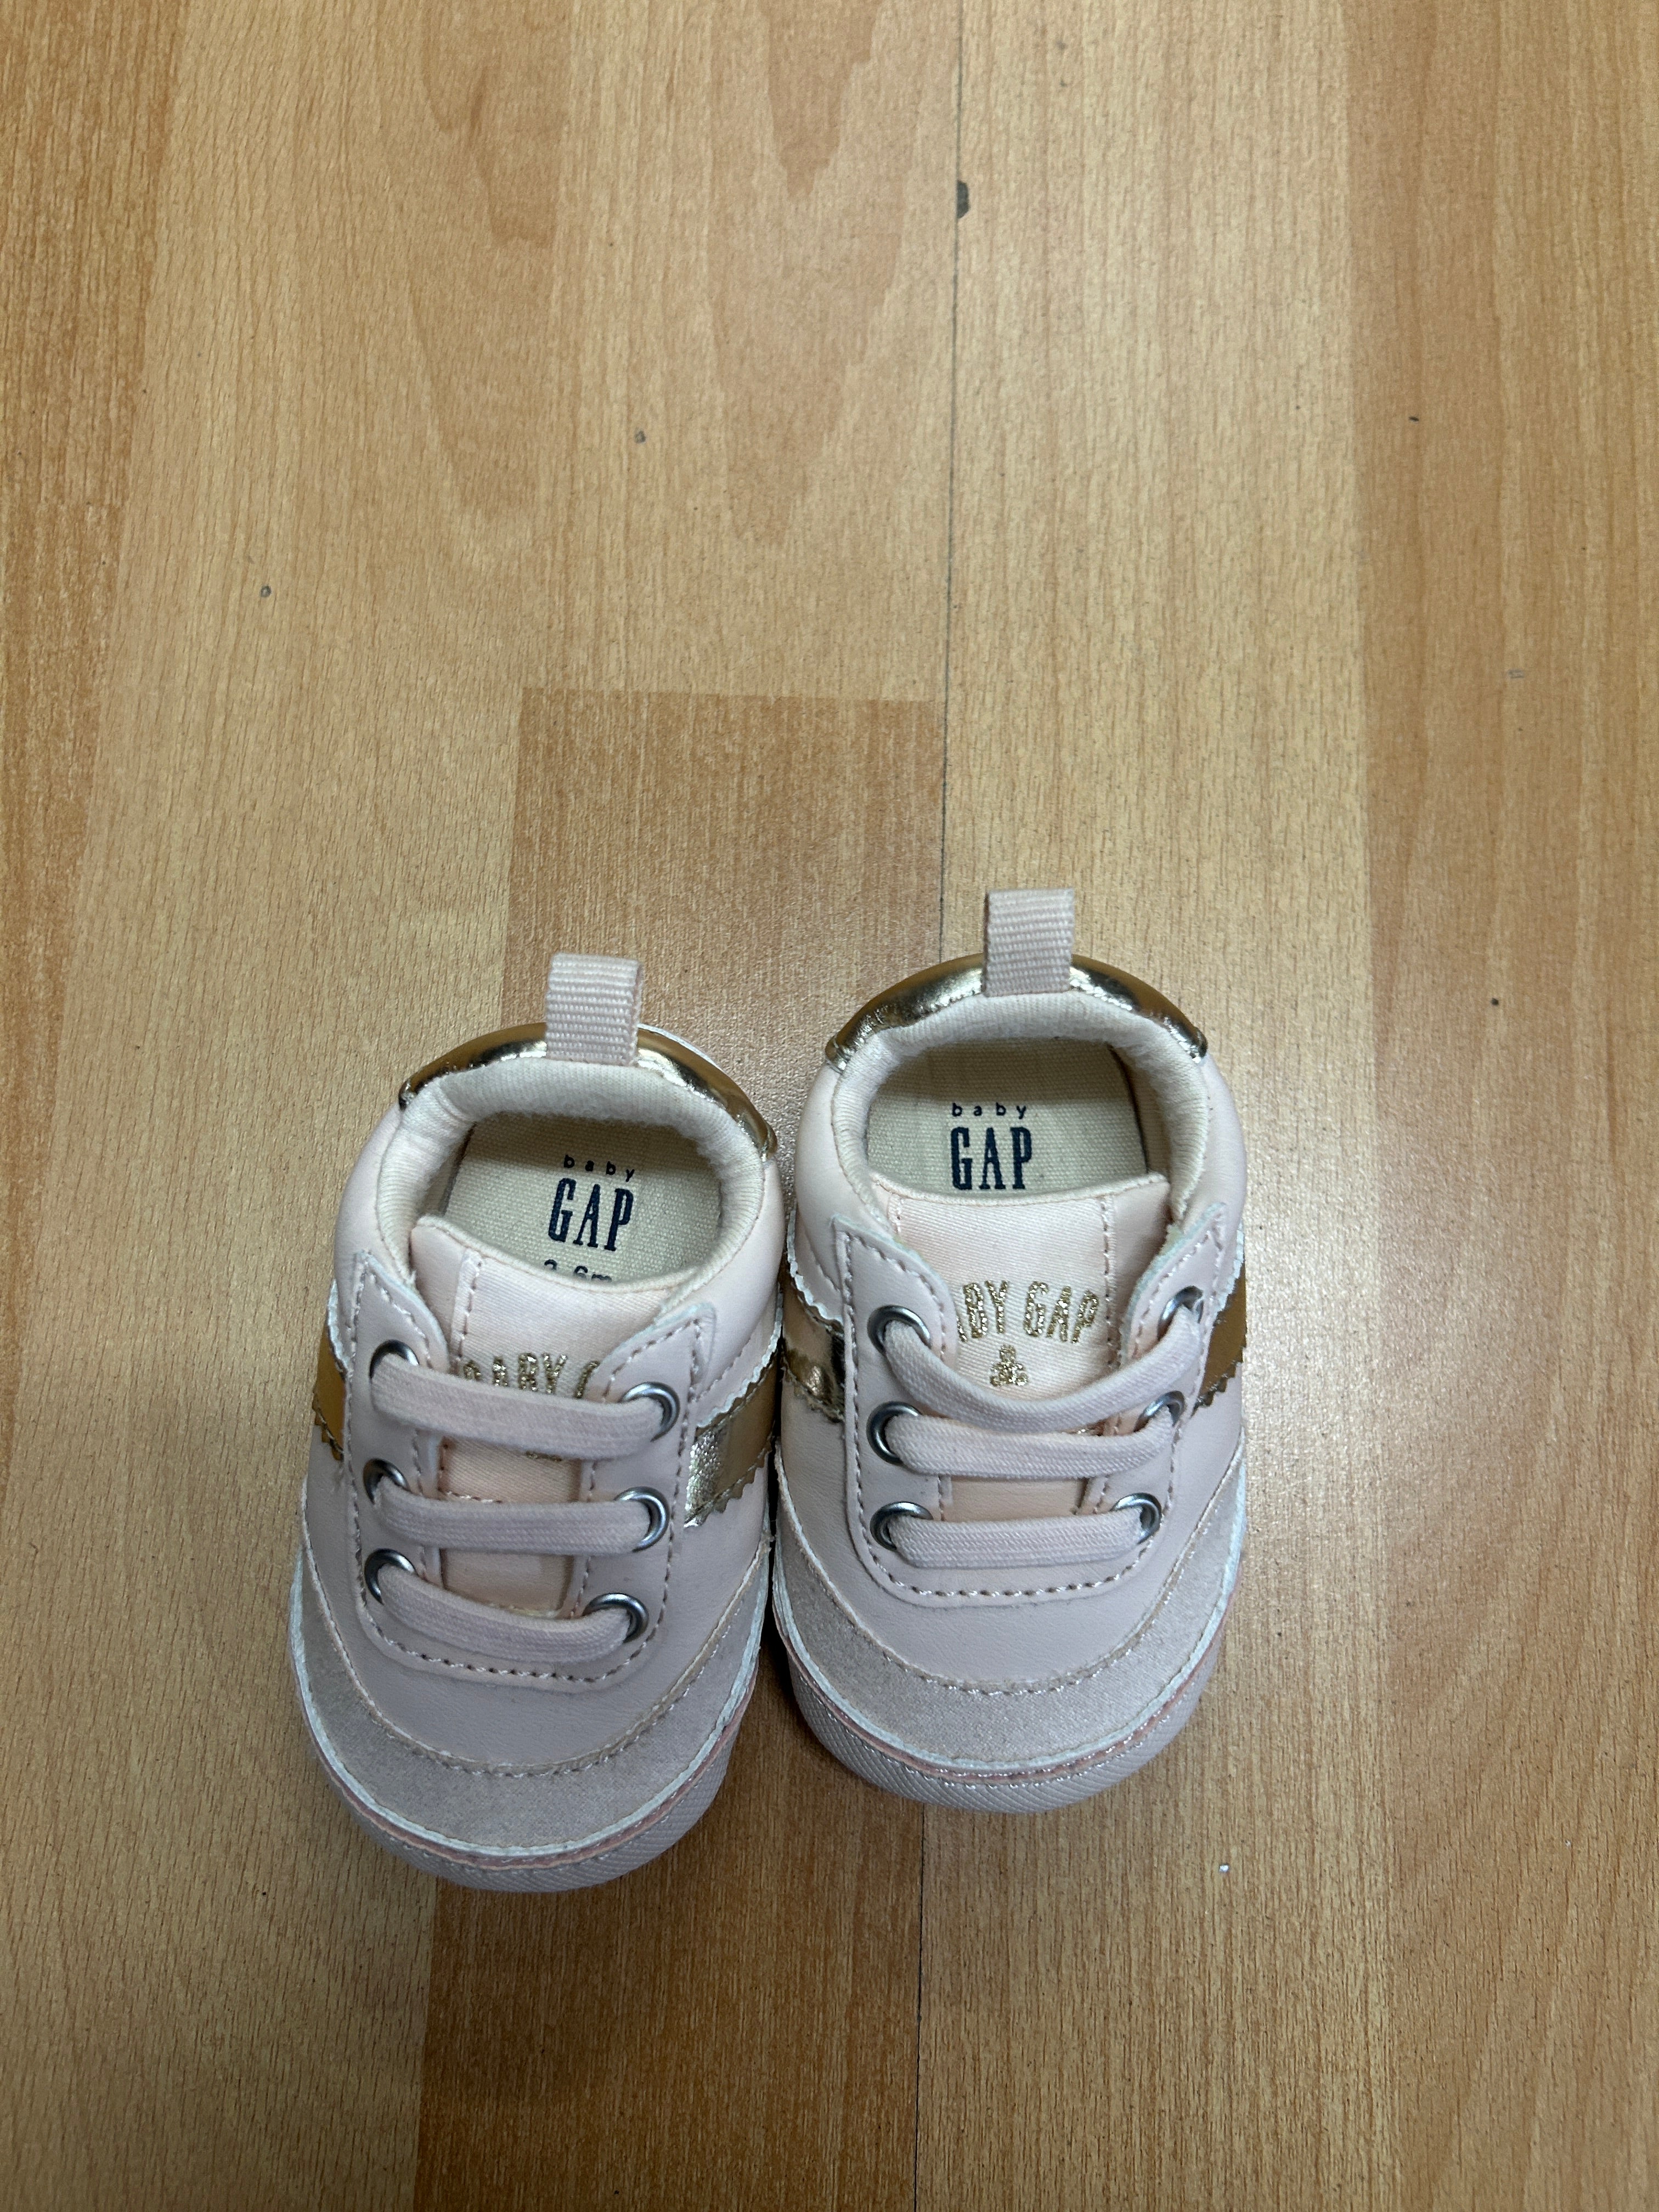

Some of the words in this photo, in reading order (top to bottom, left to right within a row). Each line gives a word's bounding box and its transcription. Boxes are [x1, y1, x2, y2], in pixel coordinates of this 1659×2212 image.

[952, 1102, 1026, 1120] baby
[563, 1154, 635, 1182] baby
[951, 1127, 1032, 1190] GAP
[549, 1178, 634, 1251] GAP
[1023, 1280, 1099, 1343] GAP
